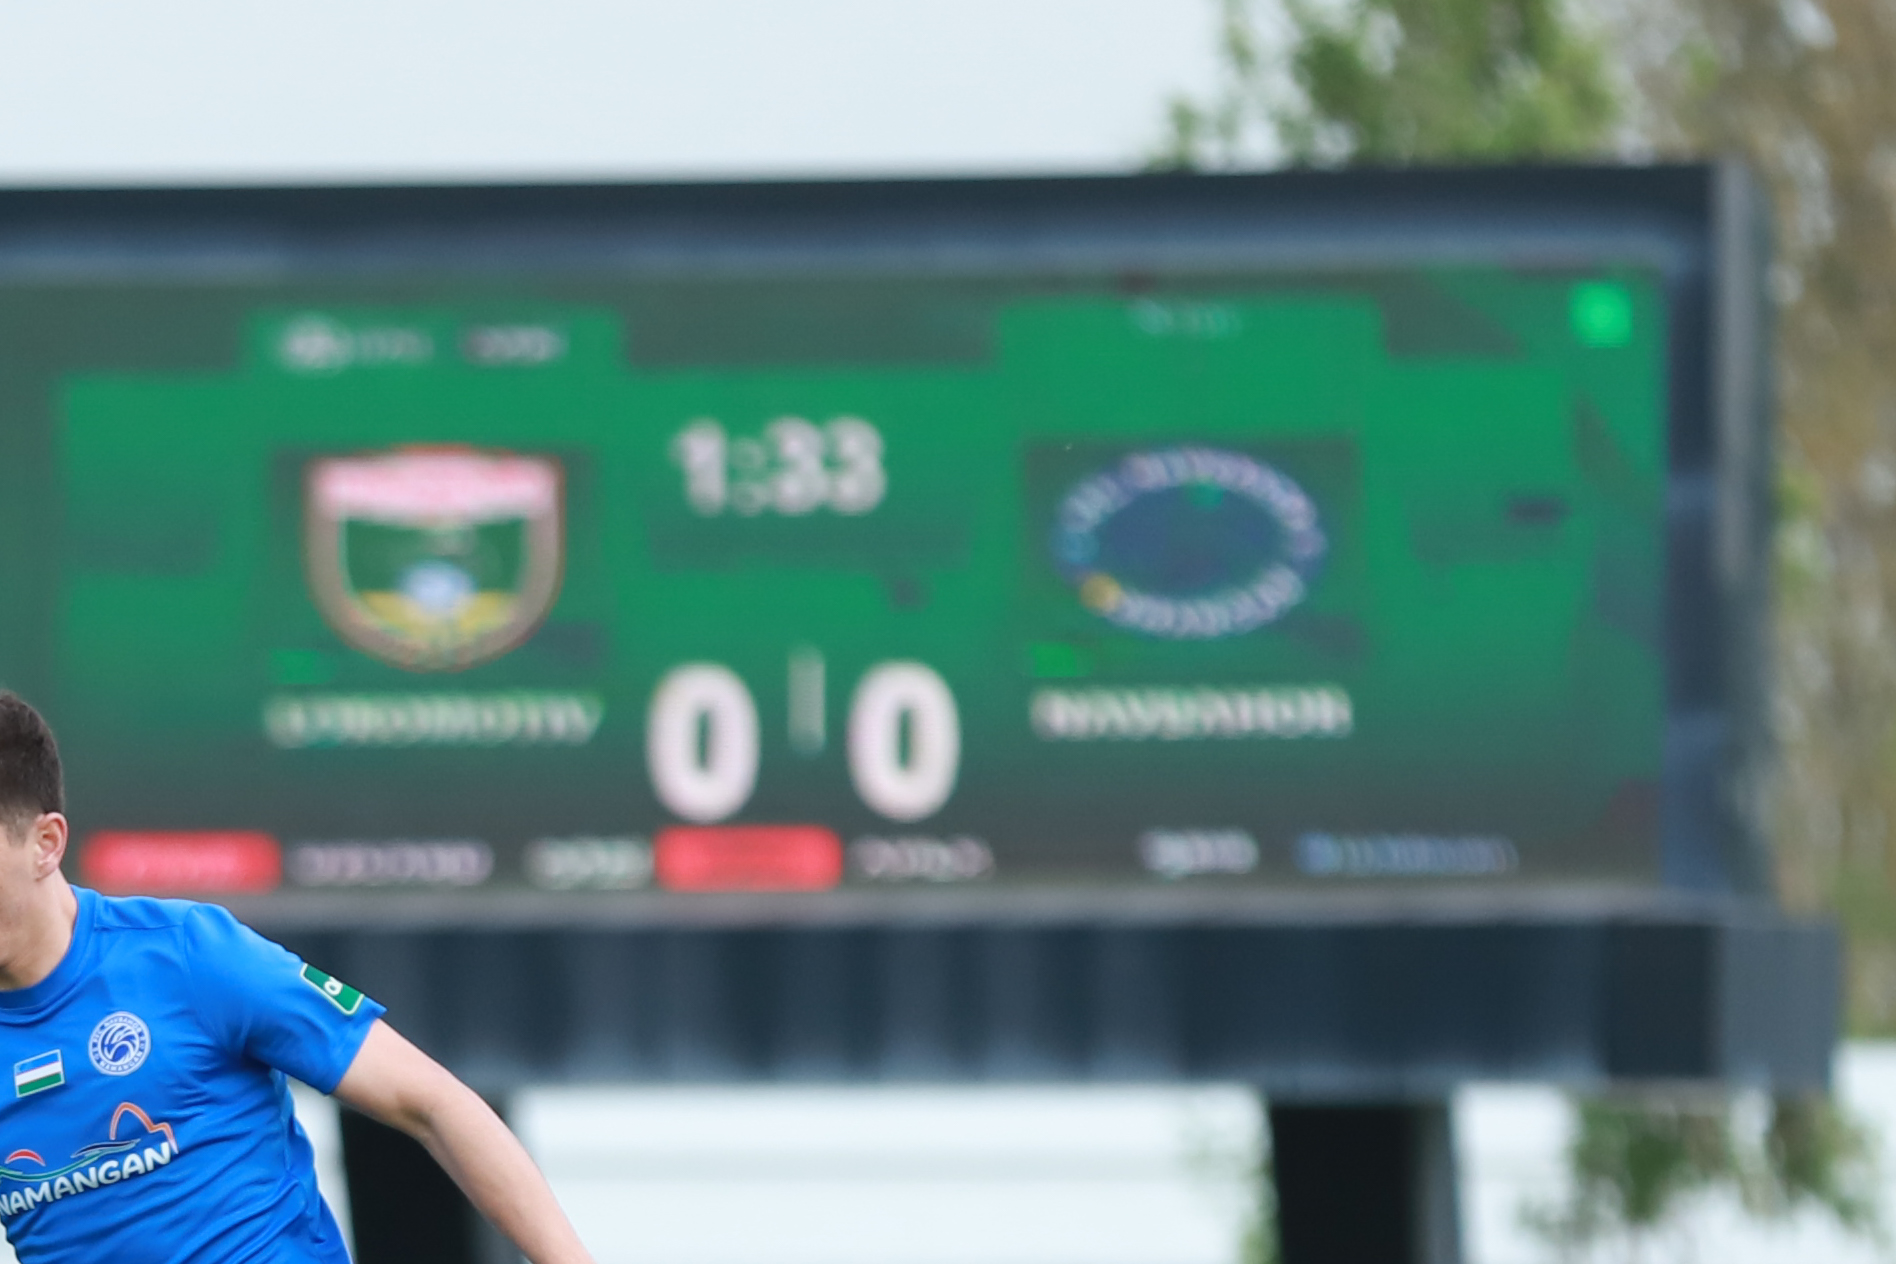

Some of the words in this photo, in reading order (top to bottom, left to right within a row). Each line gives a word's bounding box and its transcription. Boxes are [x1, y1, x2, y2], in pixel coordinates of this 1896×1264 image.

[670, 414, 888, 518] 1:33
[645, 658, 762, 826] 0
[845, 656, 963, 824] 0
